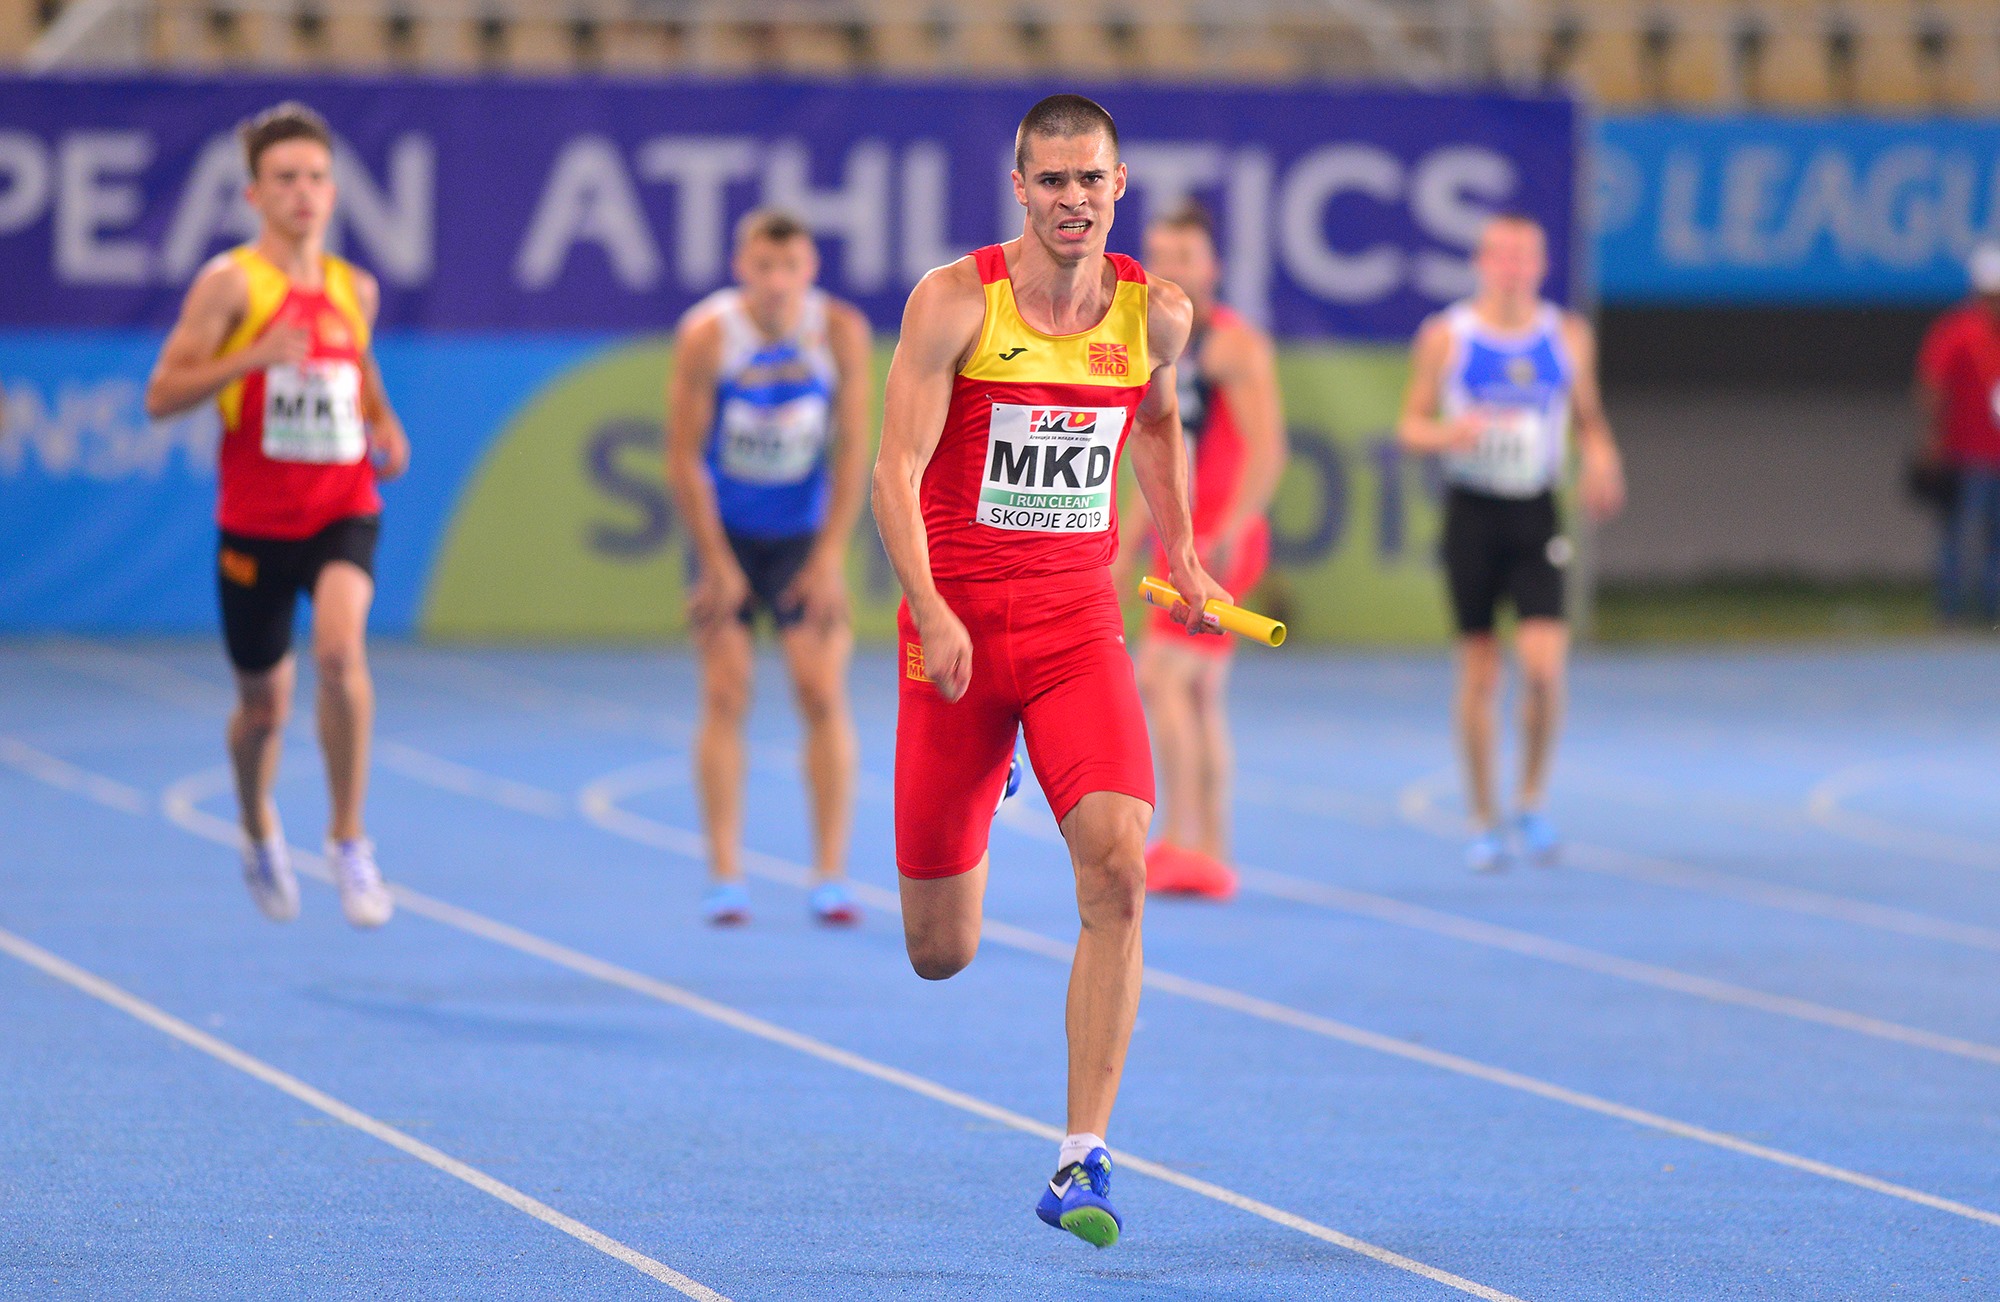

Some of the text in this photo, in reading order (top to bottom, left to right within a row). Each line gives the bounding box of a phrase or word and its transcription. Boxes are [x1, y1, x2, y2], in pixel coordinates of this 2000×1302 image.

[516, 132, 1513, 302] ATHLTICS
[1090, 362, 1126, 375] MKD
[989, 440, 1111, 488] MKD
[1009, 494, 1014, 506] I
[1016, 495, 1049, 507] RUN
[990, 508, 1102, 529] SKOPJE 2019
